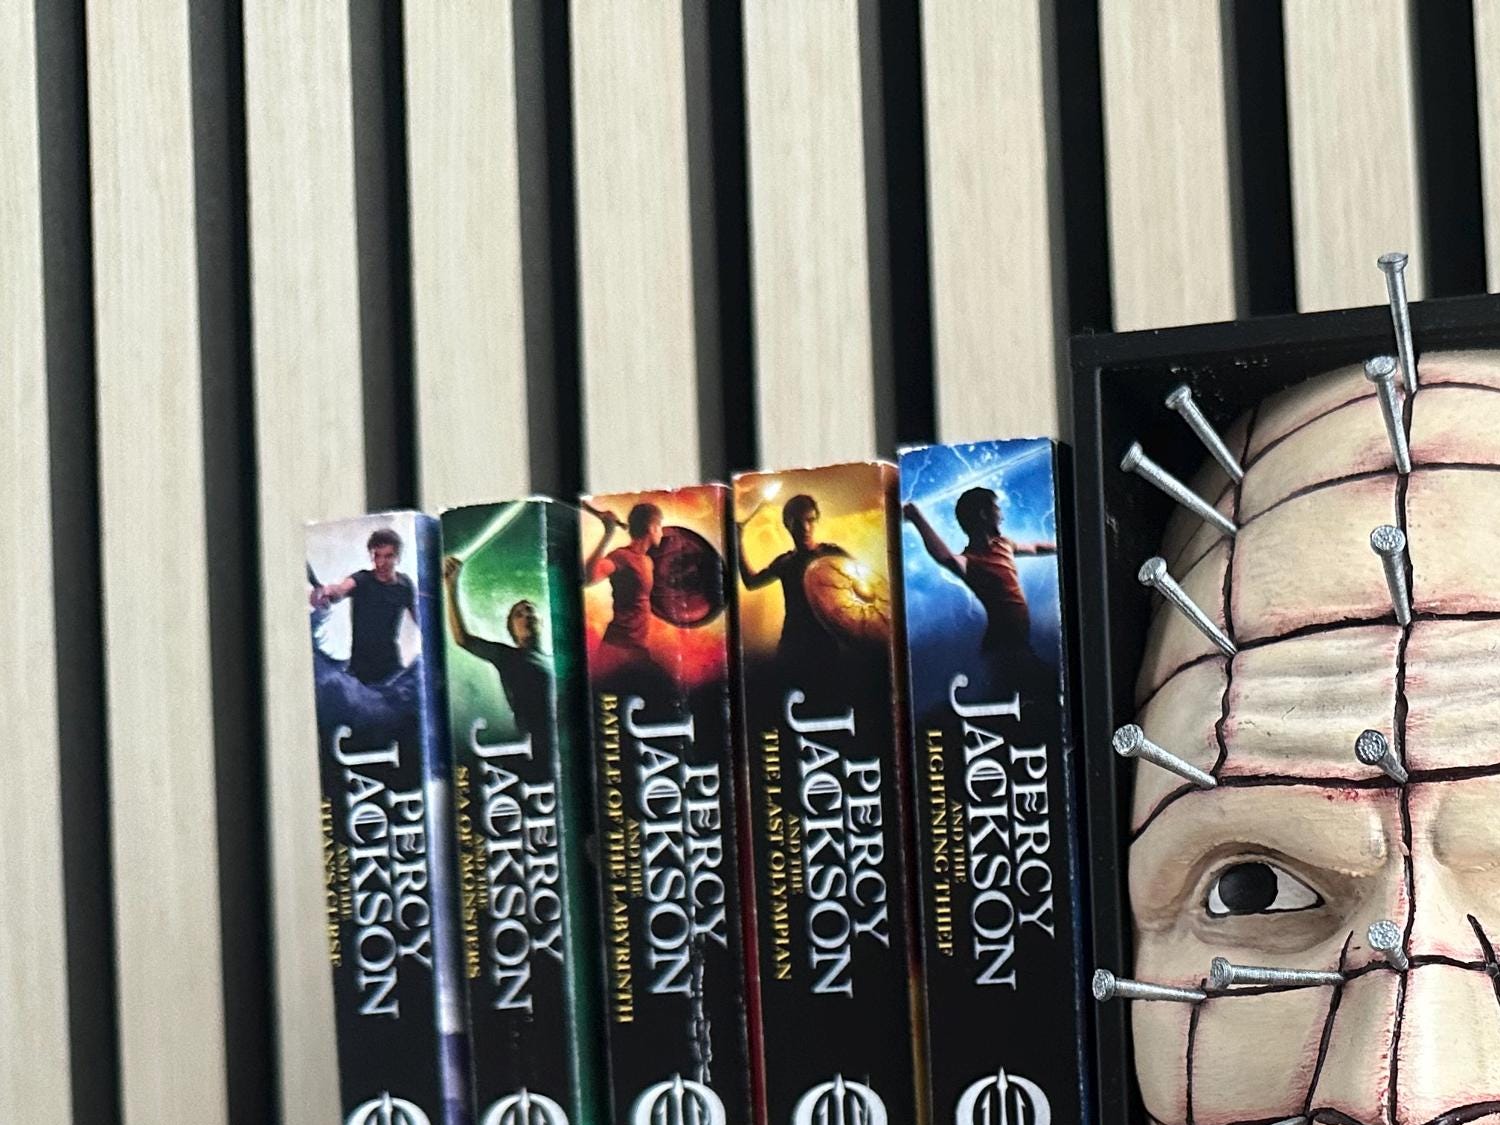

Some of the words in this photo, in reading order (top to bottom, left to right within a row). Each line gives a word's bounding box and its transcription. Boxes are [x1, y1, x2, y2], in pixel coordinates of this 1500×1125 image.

[601, 692, 621, 785] BATTLE
[762, 728, 781, 780] THE
[456, 766, 471, 811] SEA
[458, 814, 474, 848] OF
[606, 789, 625, 823] OF
[766, 785, 785, 843] LAST
[926, 729, 951, 874] LIGHTNING
[951, 800, 964, 842] AND
[334, 725, 400, 1020] JACKSON
[470, 717, 534, 1014] JACKSON
[474, 834, 487, 870] AND
[521, 781, 564, 963] PERCY
[607, 828, 627, 879] THE
[625, 696, 695, 998] JACKSON
[627, 817, 642, 858] AND
[683, 763, 728, 949] PERCY
[785, 689, 854, 1000] JACKSON
[787, 813, 801, 854] AND
[844, 757, 890, 949] PERCY
[950, 673, 1021, 991] JACKSON
[953, 846, 968, 884] THE
[1010, 743, 1056, 940] PERCY
[388, 789, 432, 968] PERCY
[460, 853, 482, 979] MONSTERS
[476, 874, 489, 911] THE
[628, 862, 644, 898] THE
[769, 850, 793, 981] OLYMPIAN
[790, 858, 805, 895] THE
[935, 879, 954, 957] THIEF
[610, 884, 635, 1024] LABYRINTH
